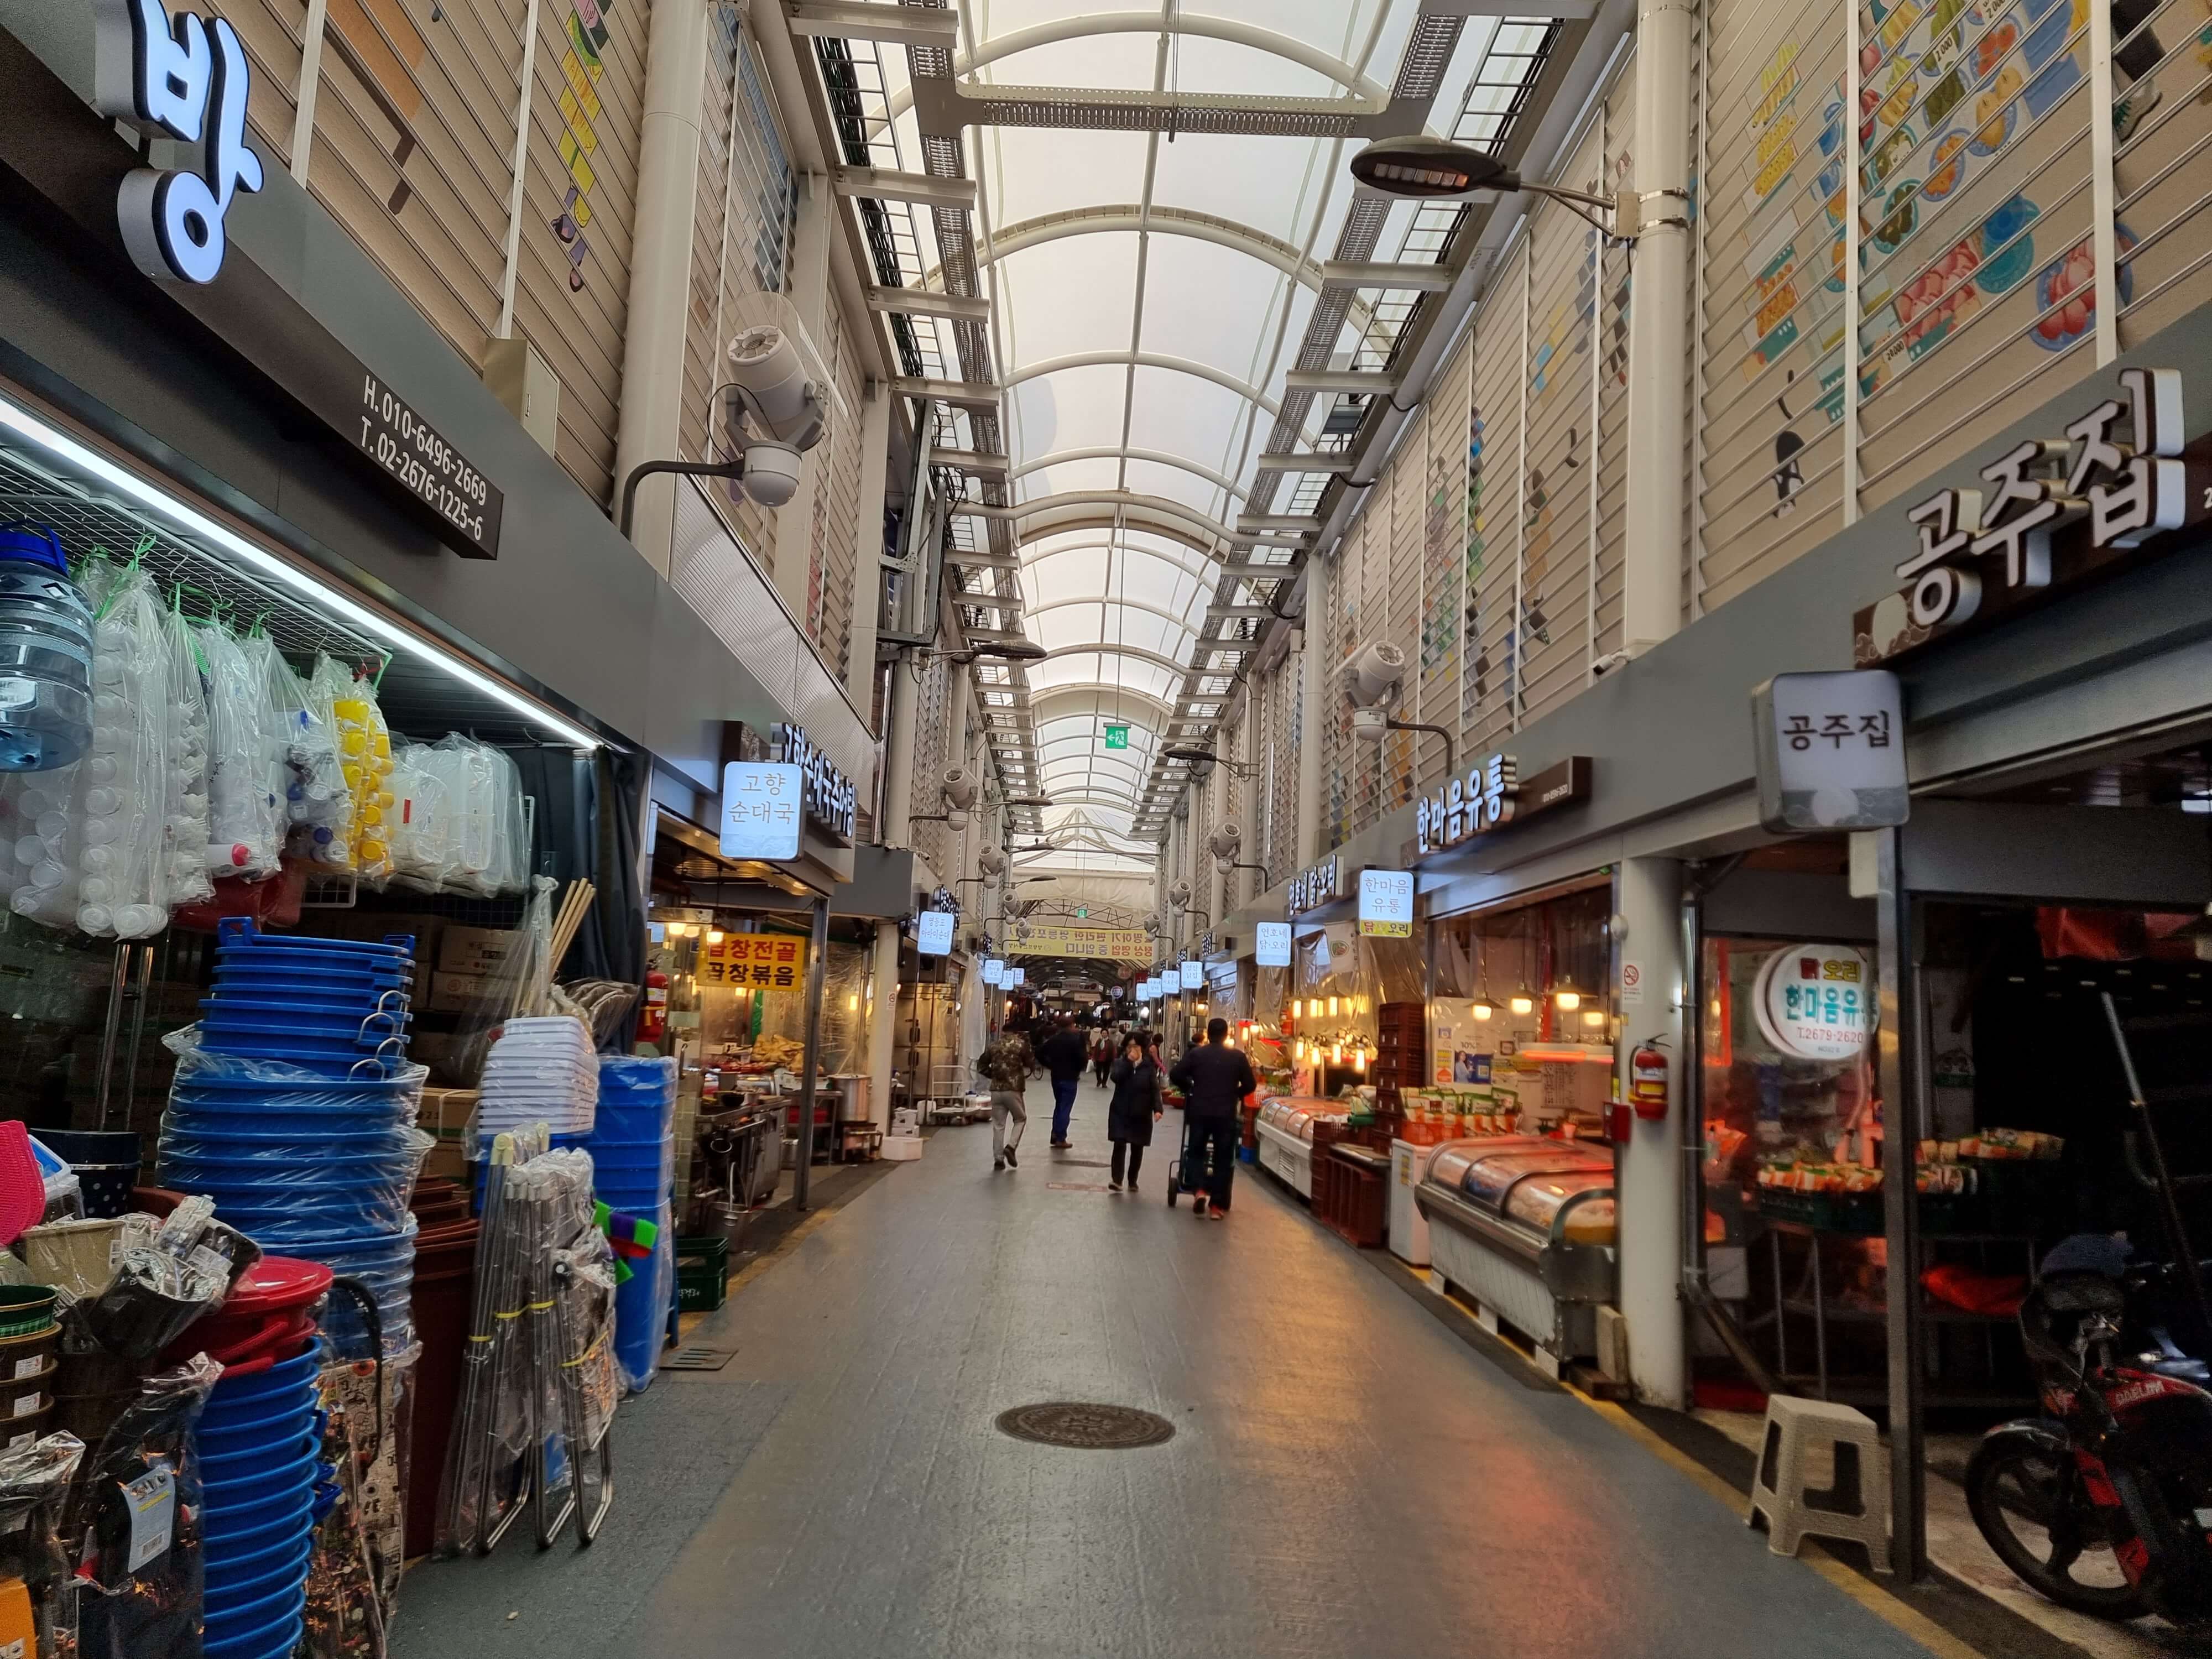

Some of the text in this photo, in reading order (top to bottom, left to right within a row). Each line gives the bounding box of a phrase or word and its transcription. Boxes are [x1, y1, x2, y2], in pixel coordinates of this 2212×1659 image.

[1894, 367, 2152, 627] 공주집
[1783, 710, 1891, 751] 공주집
[740, 773, 787, 796] 고향
[728, 801, 796, 824] 순대국
[1416, 753, 1505, 854] 한마음유통
[1364, 877, 1409, 894] 한마음
[1371, 898, 1401, 914] 유통
[1389, 923, 1408, 935] 오리
[705, 961, 795, 987] 곱창볶음
[1823, 959, 1861, 983] 오리
